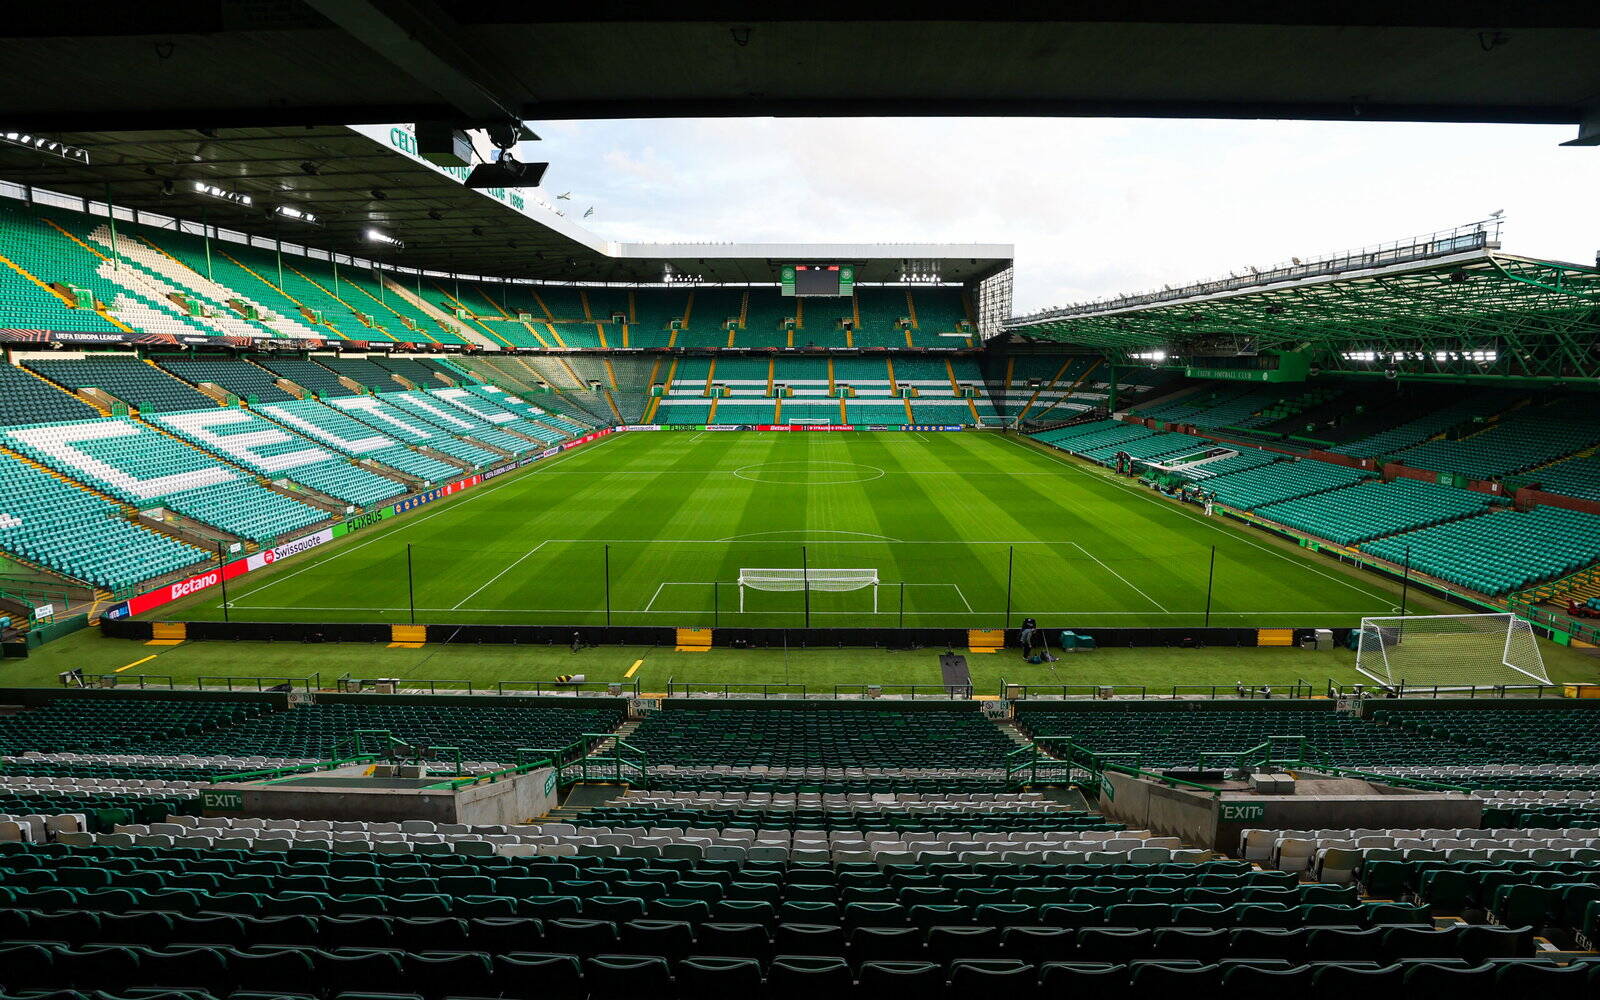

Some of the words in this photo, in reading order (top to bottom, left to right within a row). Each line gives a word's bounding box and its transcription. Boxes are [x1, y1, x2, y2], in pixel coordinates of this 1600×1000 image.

[274, 535, 321, 560] Swissquote
[171, 573, 217, 600] Betano
[988, 710, 1005, 719] W4
[204, 794, 237, 807] EXIT
[1223, 806, 1260, 819] EXIT
